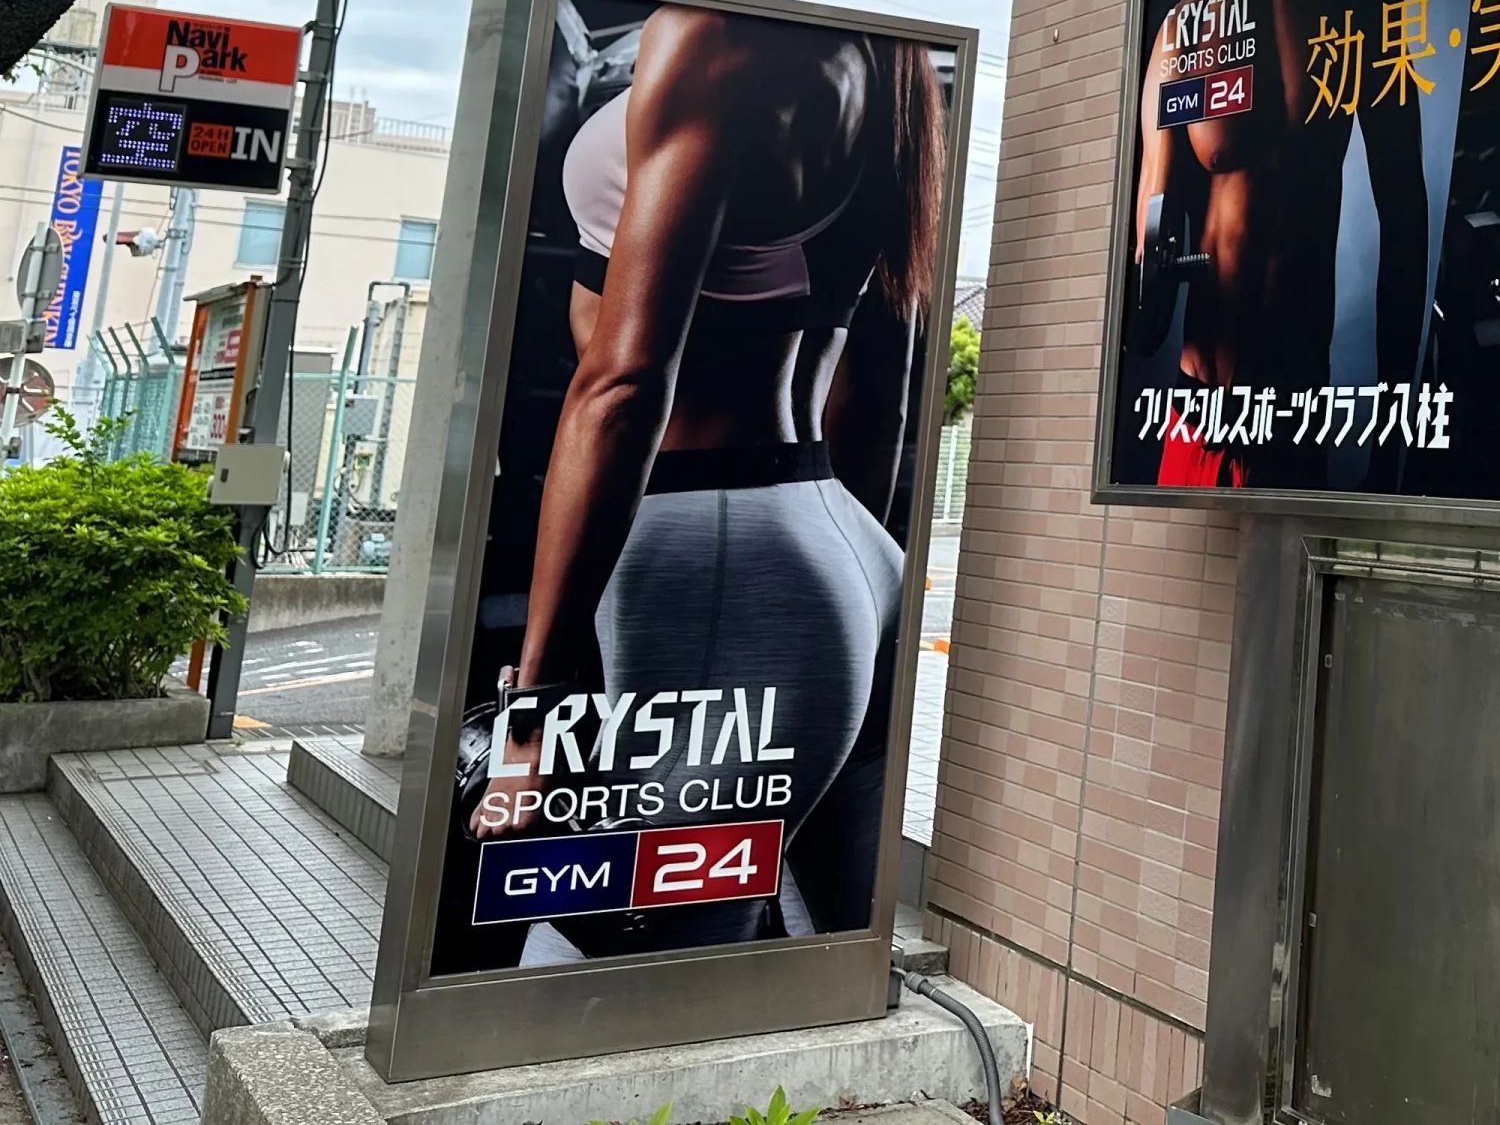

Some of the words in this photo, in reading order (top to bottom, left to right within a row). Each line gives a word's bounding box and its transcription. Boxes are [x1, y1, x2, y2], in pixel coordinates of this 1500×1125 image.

[166, 19, 231, 53] Navi
[1160, 48, 1214, 77] SPORTS
[1217, 37, 1256, 65] CLUB
[159, 43, 248, 93] Park
[1166, 93, 1199, 113] GYM
[1210, 76, 1245, 110] 24
[101, 102, 184, 169] 空
[190, 139, 228, 154] OPEN
[231, 126, 281, 163] IN
[487, 686, 795, 779] CRYSTAL
[480, 782, 665, 827] SPORTS
[679, 775, 793, 813] CLUB
[504, 861, 611, 896] GYM
[653, 838, 758, 893] 24
